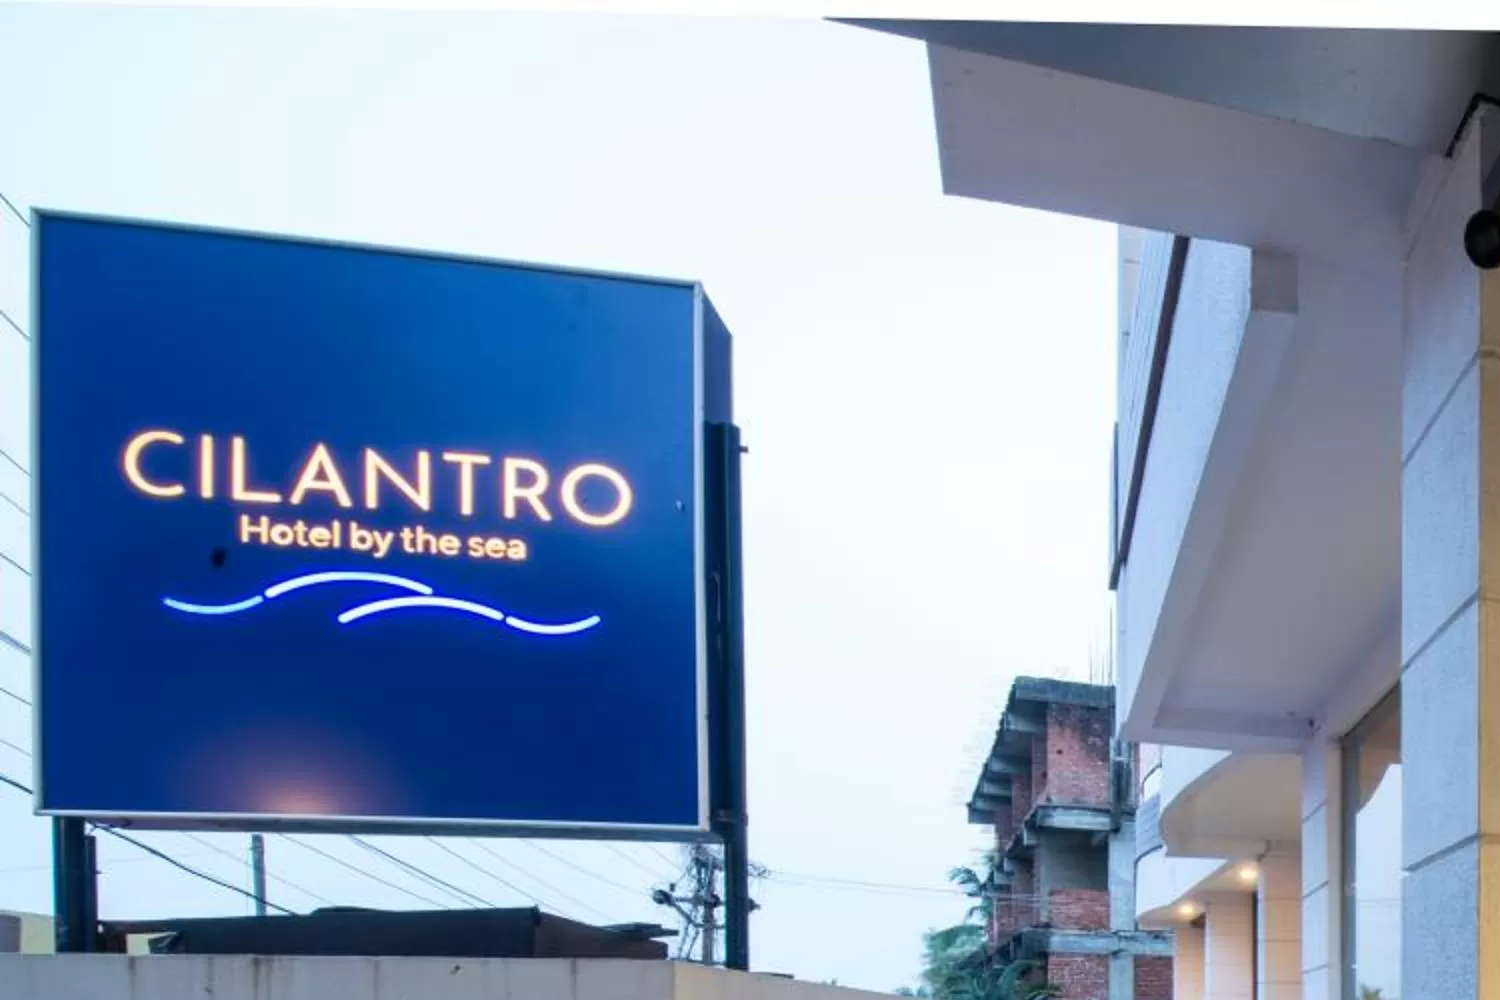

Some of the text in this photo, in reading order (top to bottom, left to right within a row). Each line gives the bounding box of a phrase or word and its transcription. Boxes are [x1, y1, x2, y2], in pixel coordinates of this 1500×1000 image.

[123, 429, 633, 526] CILANTRO
[240, 514, 527, 560] Hotel by the sea
